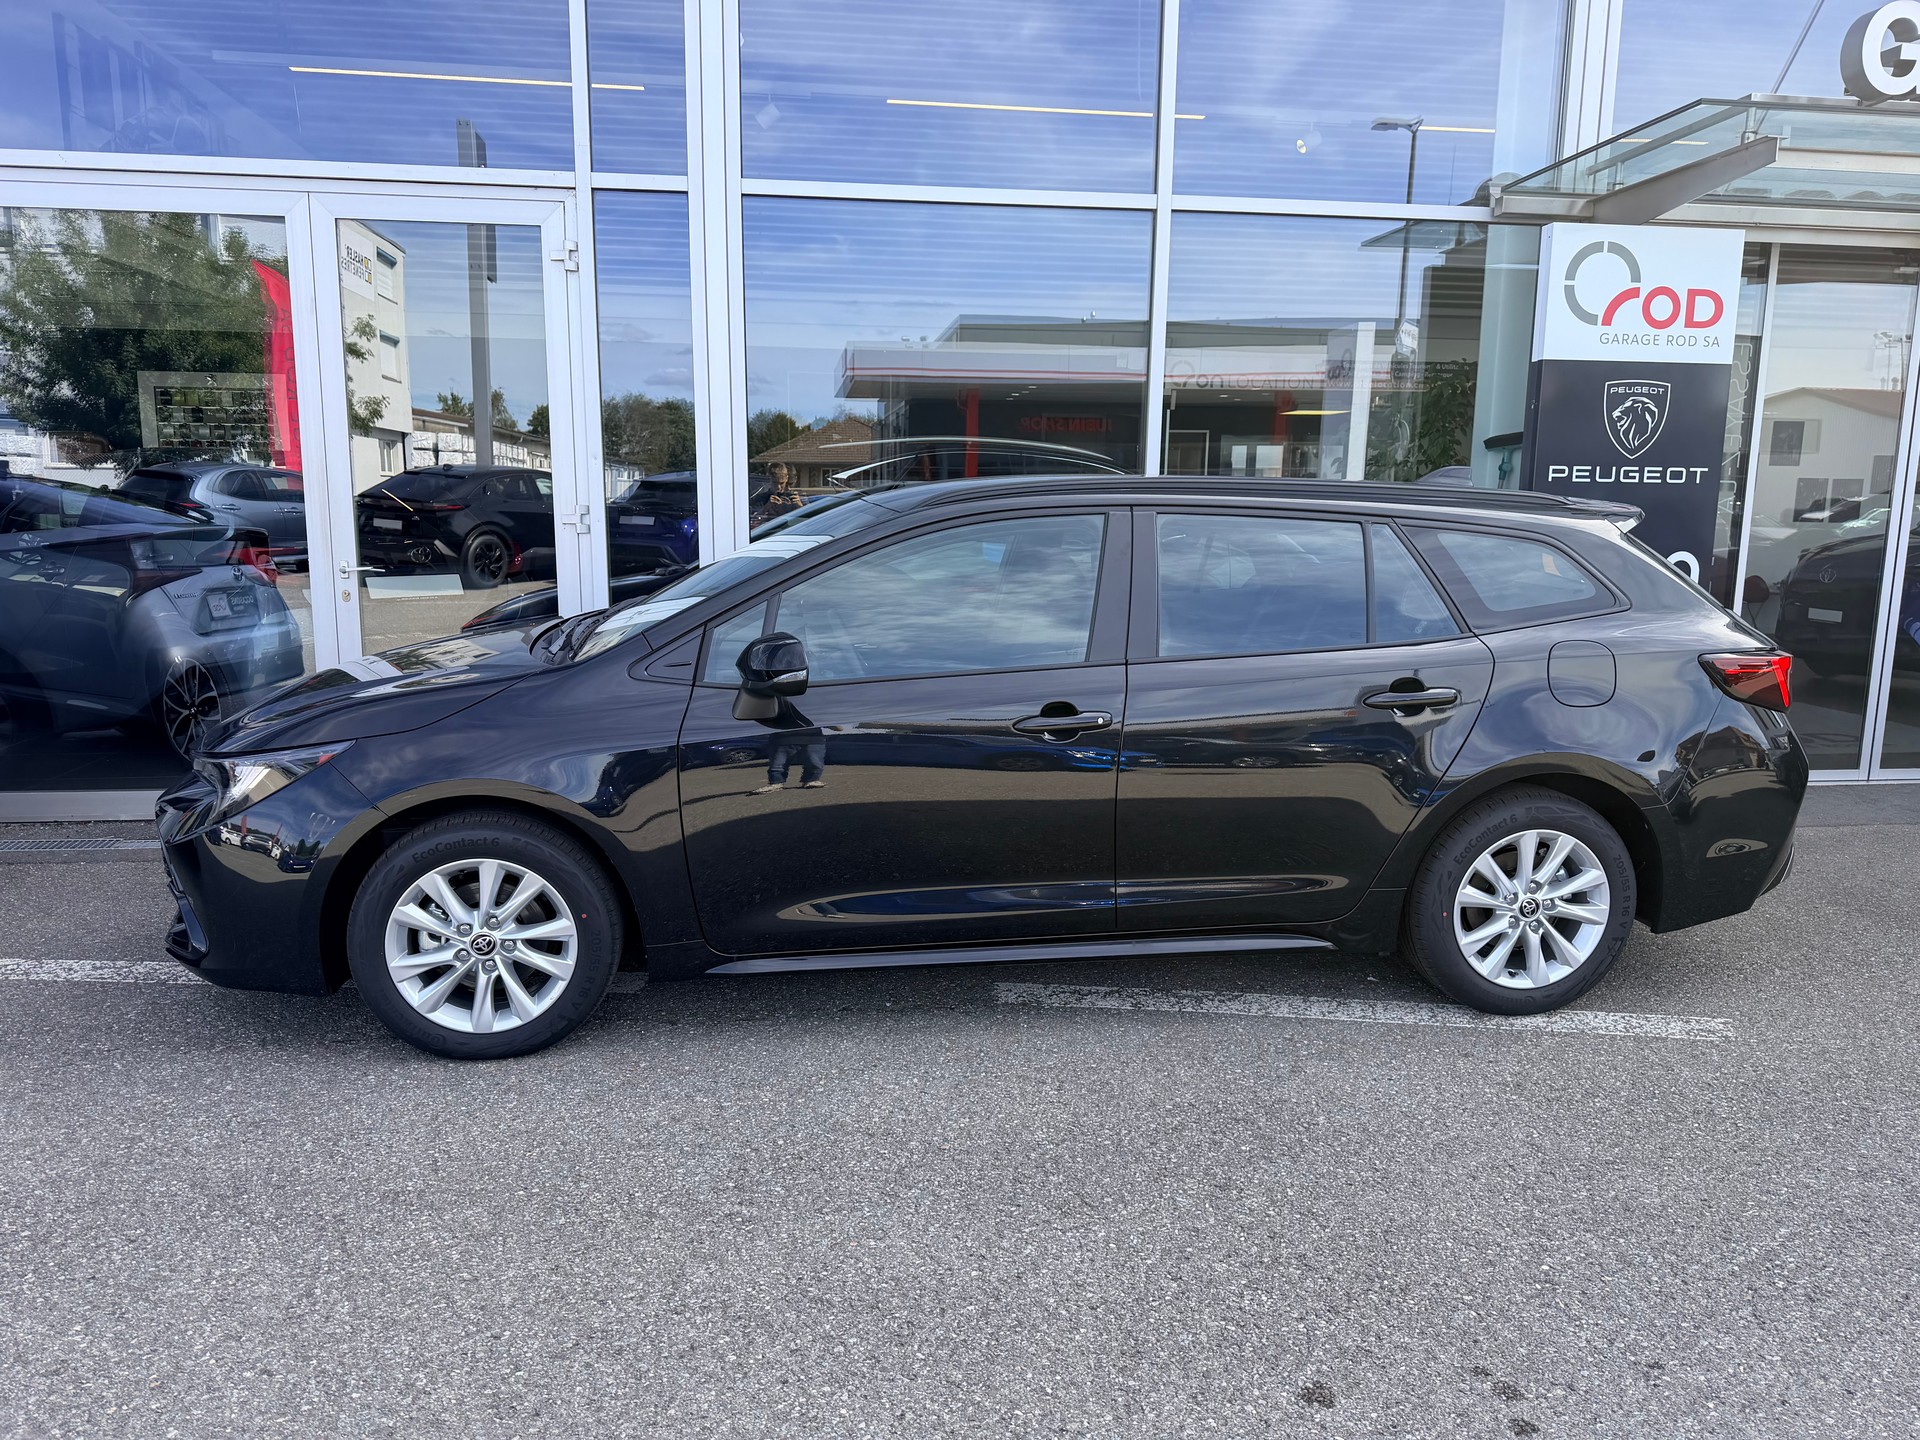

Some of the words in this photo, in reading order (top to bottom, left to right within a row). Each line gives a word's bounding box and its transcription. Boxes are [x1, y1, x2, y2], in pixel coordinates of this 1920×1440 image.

[1599, 333, 1661, 346] GARAGE
[1666, 335, 1698, 347] ROD
[1703, 336, 1720, 348] SA
[1228, 375, 1314, 389] LOCATION
[1610, 386, 1665, 395] PEUGEOT
[1547, 465, 1709, 485] PEUGEOT
[1453, 817, 1509, 865] EcoContact
[1509, 813, 1518, 824] 6
[411, 836, 488, 864] EcoContact
[490, 836, 500, 847] 6
[1613, 855, 1631, 892] 205/55
